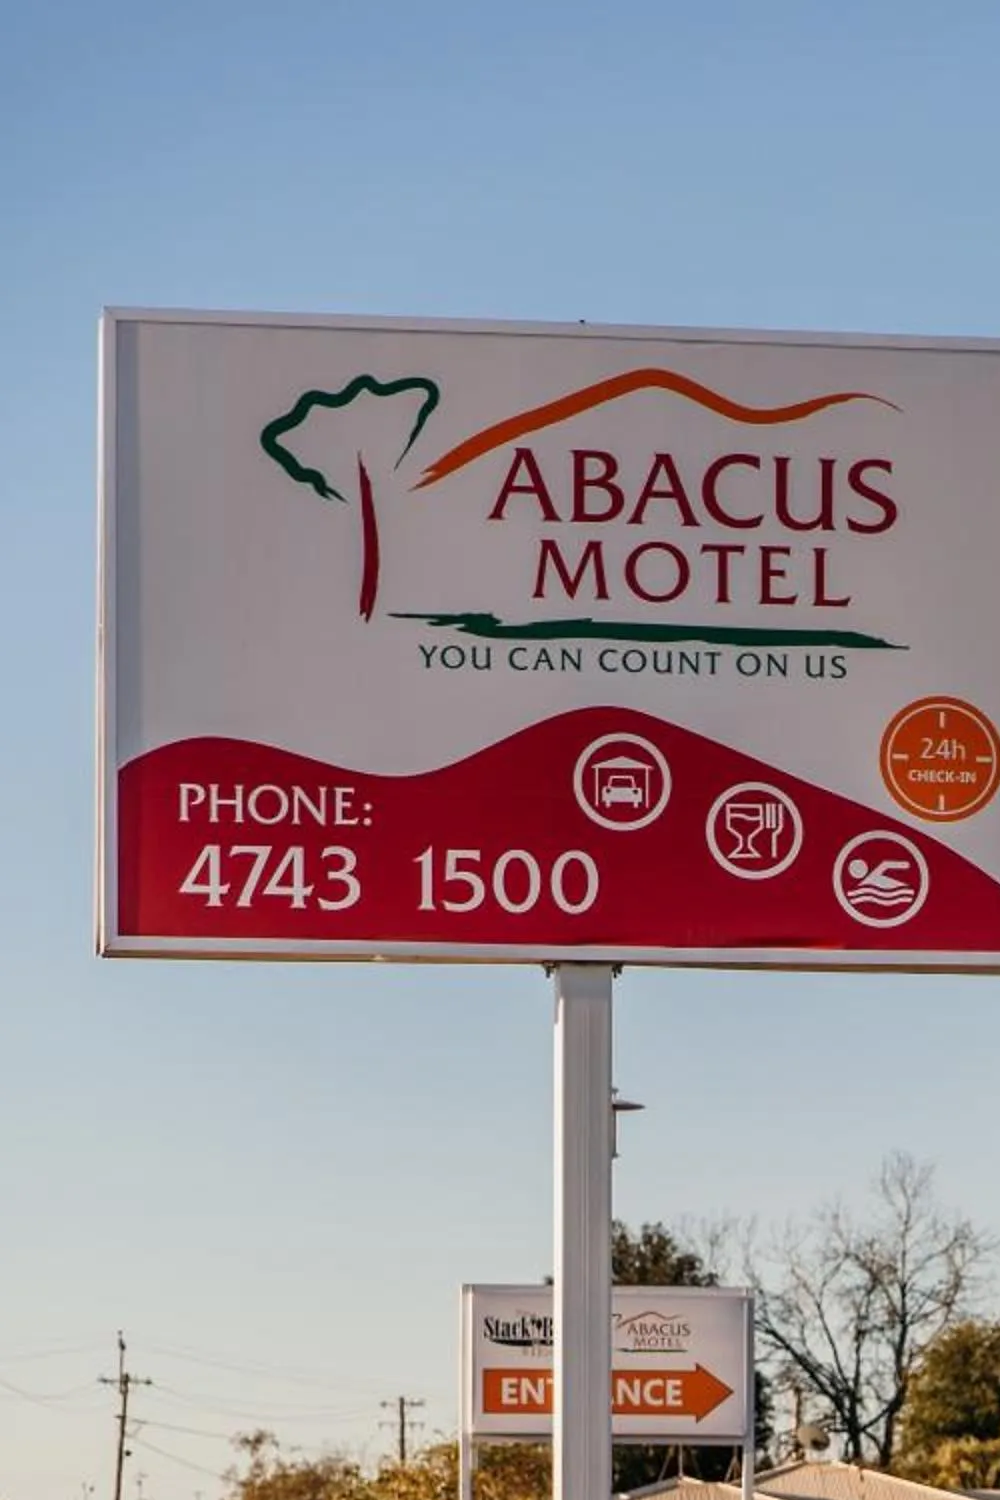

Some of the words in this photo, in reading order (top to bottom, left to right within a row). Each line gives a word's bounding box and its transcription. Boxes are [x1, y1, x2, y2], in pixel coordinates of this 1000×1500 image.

[486, 447, 898, 535] ABACUS
[531, 538, 852, 608] MOTEL
[418, 643, 493, 671] YOU
[508, 645, 583, 673] CAN
[598, 648, 723, 676] COUNT
[735, 652, 789, 679] ON
[804, 653, 848, 680] US
[919, 737, 967, 761] 24h
[907, 767, 978, 784] CHECK-IN
[178, 783, 373, 827] PHONE:
[179, 844, 362, 911] 4743
[414, 846, 600, 914] 1500
[627, 1322, 691, 1337] ABACUS
[633, 1337, 683, 1347] MOTEL
[501, 1377, 684, 1407] ENNCE
